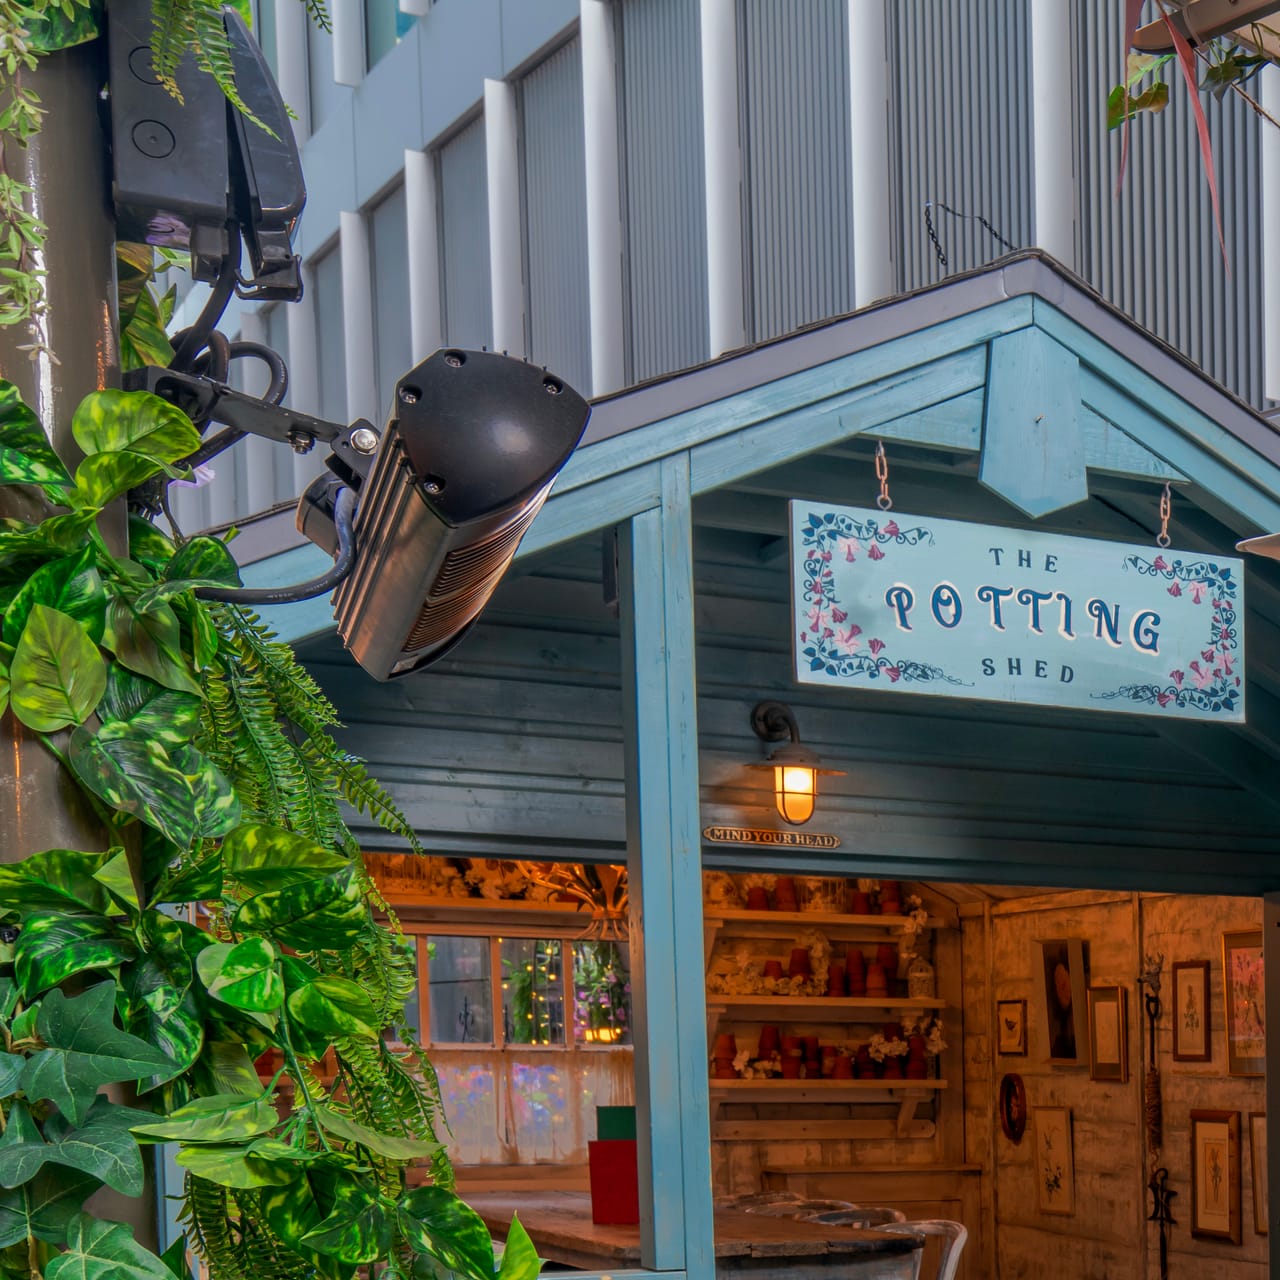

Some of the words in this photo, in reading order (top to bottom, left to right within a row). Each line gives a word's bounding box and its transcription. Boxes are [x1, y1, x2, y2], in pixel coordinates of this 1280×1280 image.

[988, 547, 1059, 573] THE
[884, 581, 1162, 656] POTTING
[981, 657, 1075, 684] SHED
[713, 828, 752, 841] MIND
[753, 831, 792, 844] YOUR
[795, 834, 833, 846] HEAD
